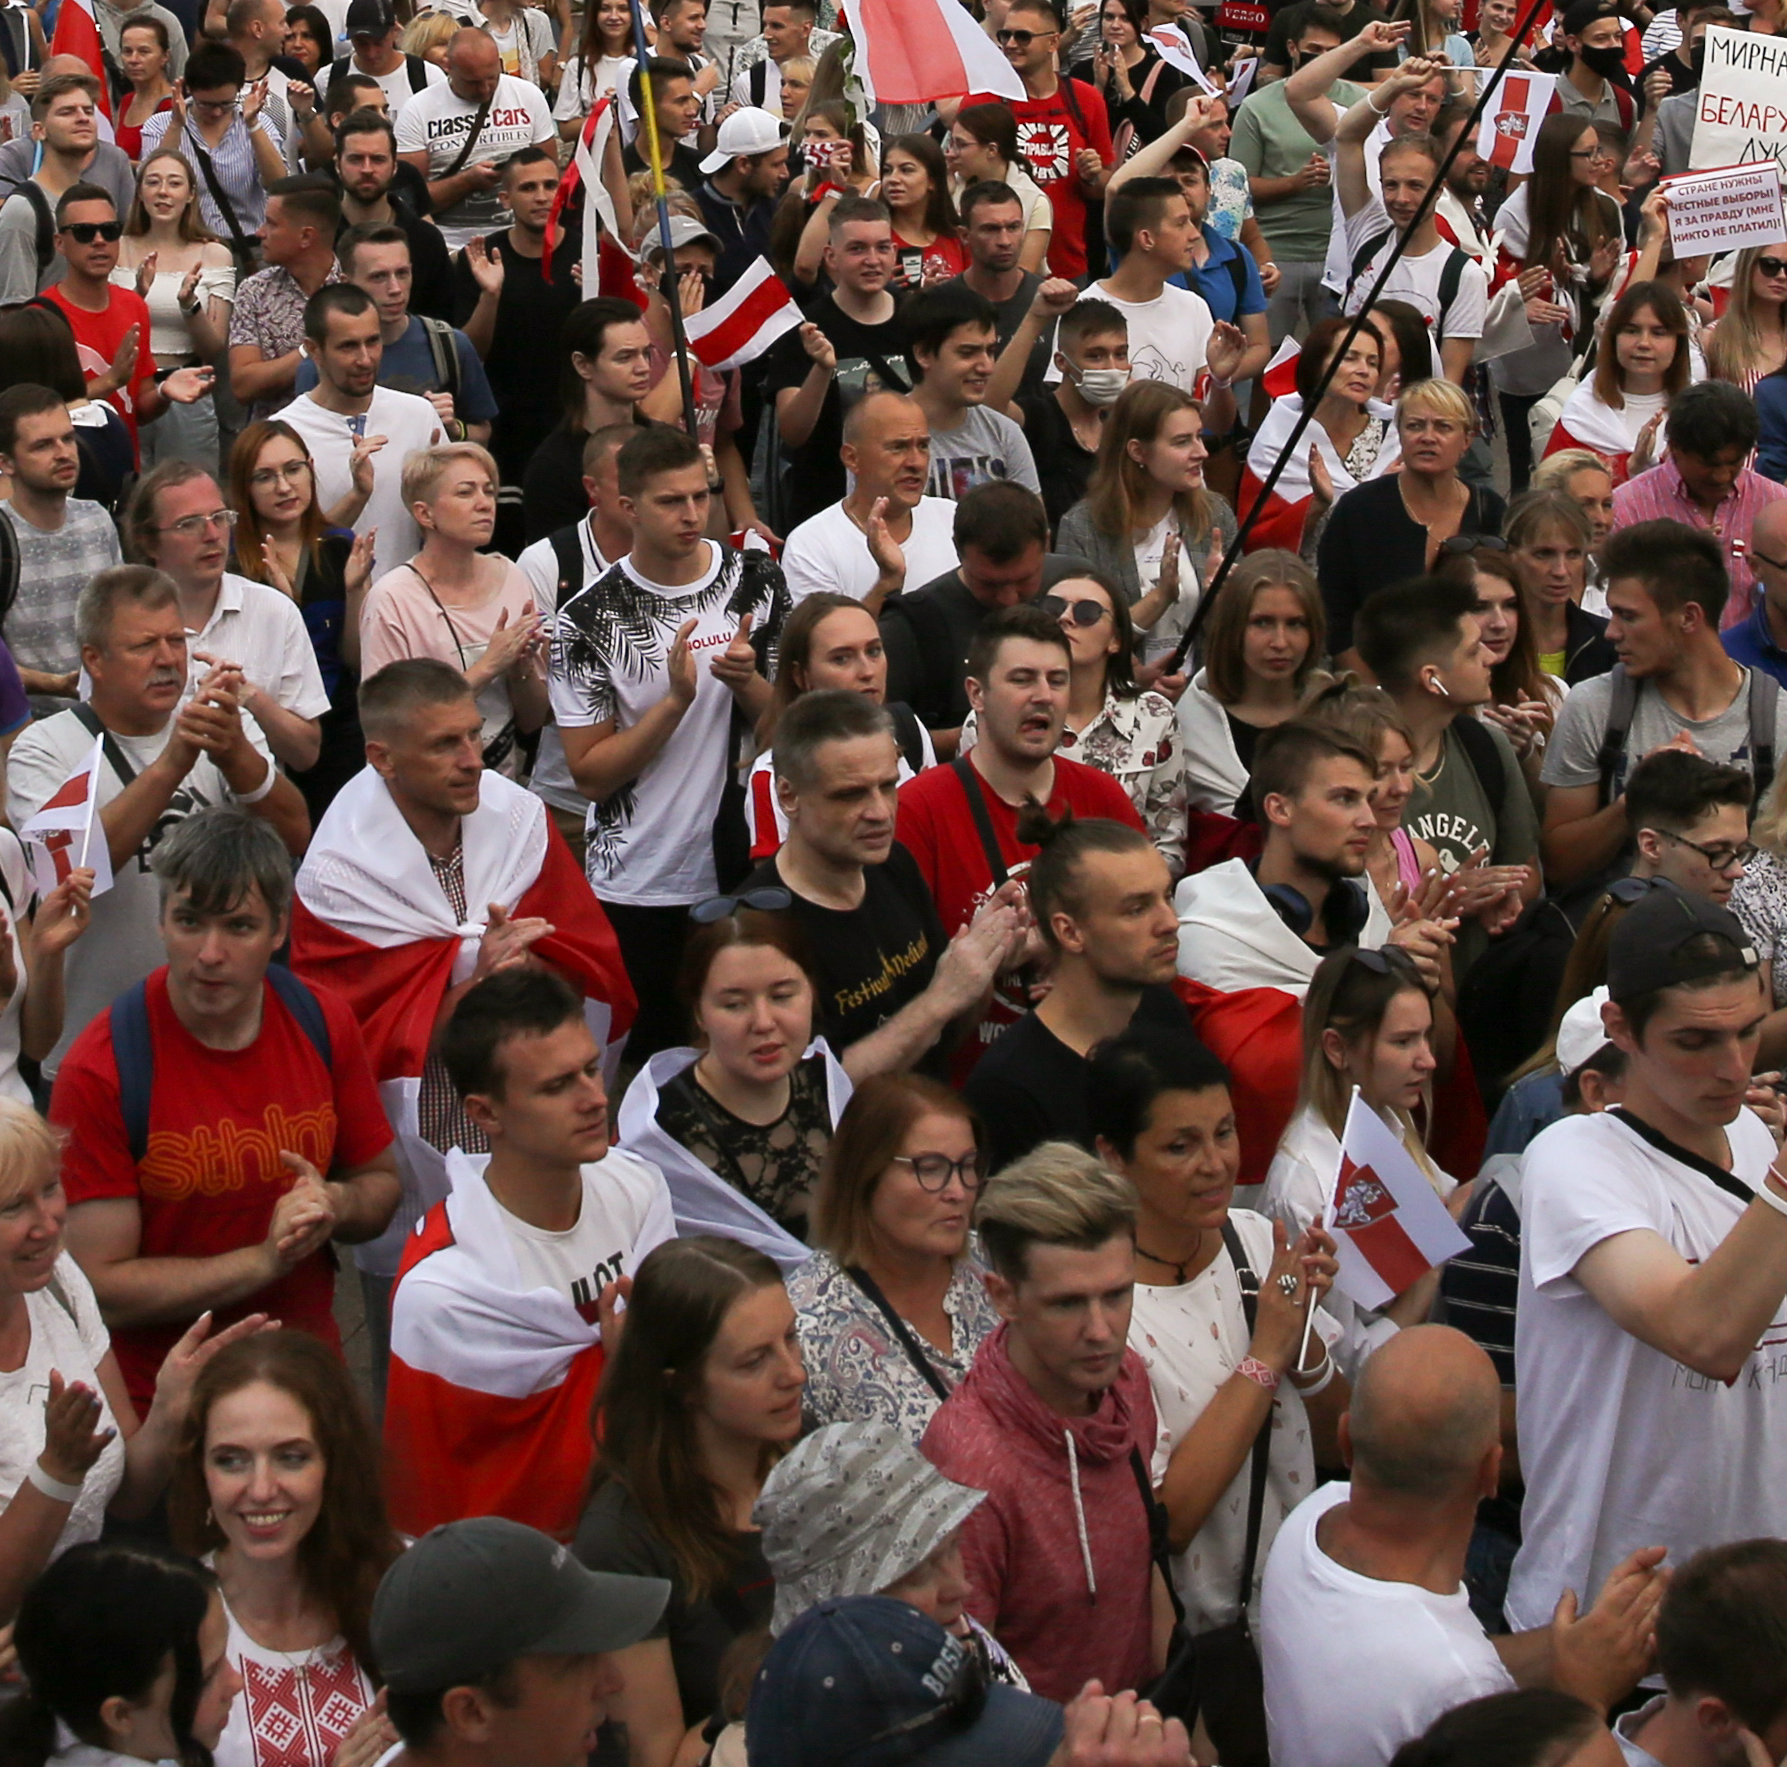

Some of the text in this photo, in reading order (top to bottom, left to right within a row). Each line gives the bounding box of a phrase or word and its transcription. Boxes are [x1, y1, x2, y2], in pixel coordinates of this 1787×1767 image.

[1224, 7, 1265, 23] VERSO
[431, 130, 530, 153] CONVRTIBLES
[1678, 175, 1763, 196] СТРАНЕ НУЖНЫ
[1670, 189, 1775, 212] ЧЕСТНЫЕ ВЫБОРЫ!
[1675, 203, 1775, 228] Я ЗА ПРАВДУ (МНЕ
[1673, 218, 1781, 244] НИКТО НЕ ПЛАТИЛ)!
